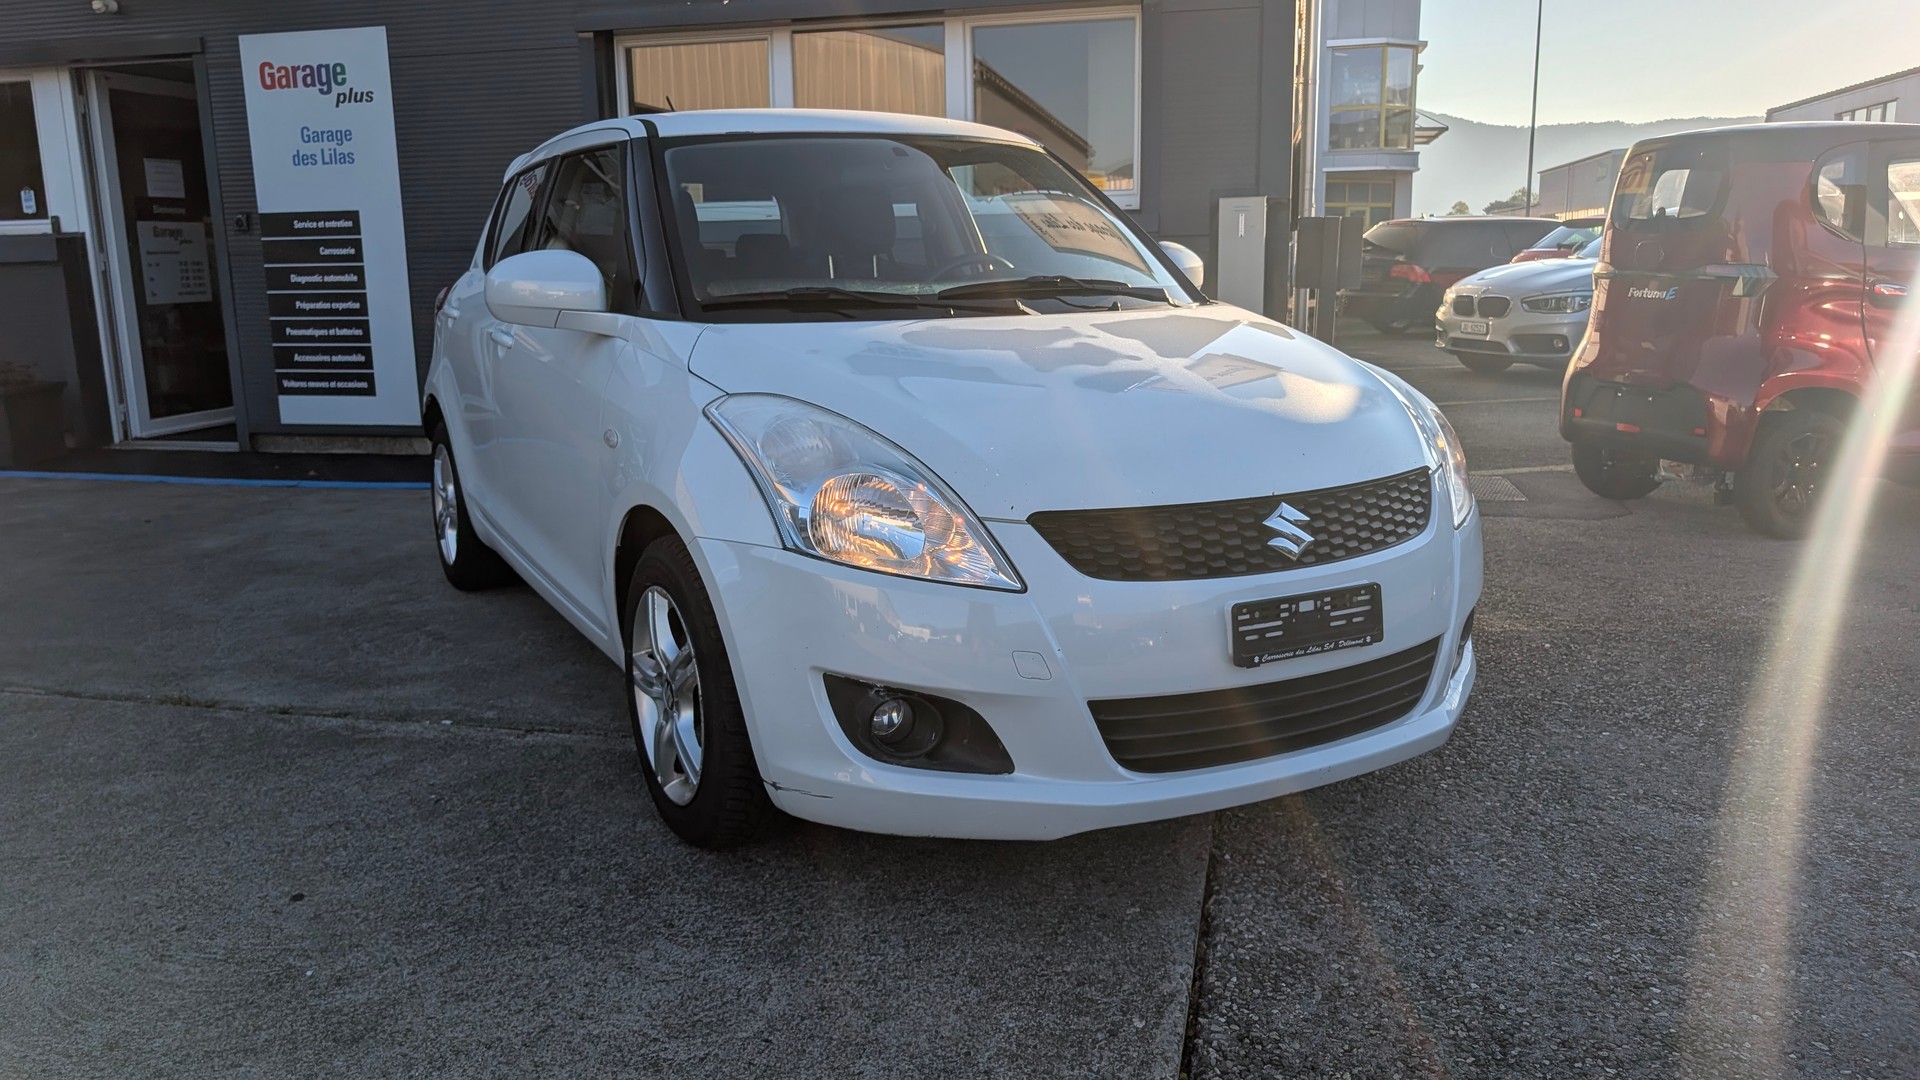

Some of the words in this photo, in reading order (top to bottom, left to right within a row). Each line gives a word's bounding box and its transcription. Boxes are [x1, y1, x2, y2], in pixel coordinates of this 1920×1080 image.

[259, 61, 347, 95] Garage
[335, 88, 374, 108] plus
[301, 126, 352, 146] Garage
[292, 149, 318, 166] des
[321, 148, 355, 165] Lilas
[293, 219, 318, 229] Service
[318, 220, 325, 229] et
[325, 218, 353, 228] entretien
[319, 246, 356, 256] Carrosserie
[290, 273, 323, 284] Diagnostic
[324, 273, 358, 283] automobile
[295, 300, 331, 311] Préparation
[331, 300, 360, 311] expertise
[285, 327, 328, 337] Pneumatiques
[329, 327, 336, 336] et
[335, 327, 363, 336] batteries
[293, 353, 331, 362] Accessoires
[331, 353, 366, 362] automobile
[282, 379, 307, 388] Voitures
[308, 380, 329, 388] neuves
[330, 379, 336, 388] et
[337, 379, 369, 389] occasions
[1261, 651, 1294, 663] Carrosserie
[1295, 648, 1305, 656] des
[1306, 646, 1322, 654] Lilas
[1323, 642, 1335, 650] SA
[1338, 637, 1364, 648] Delémont
